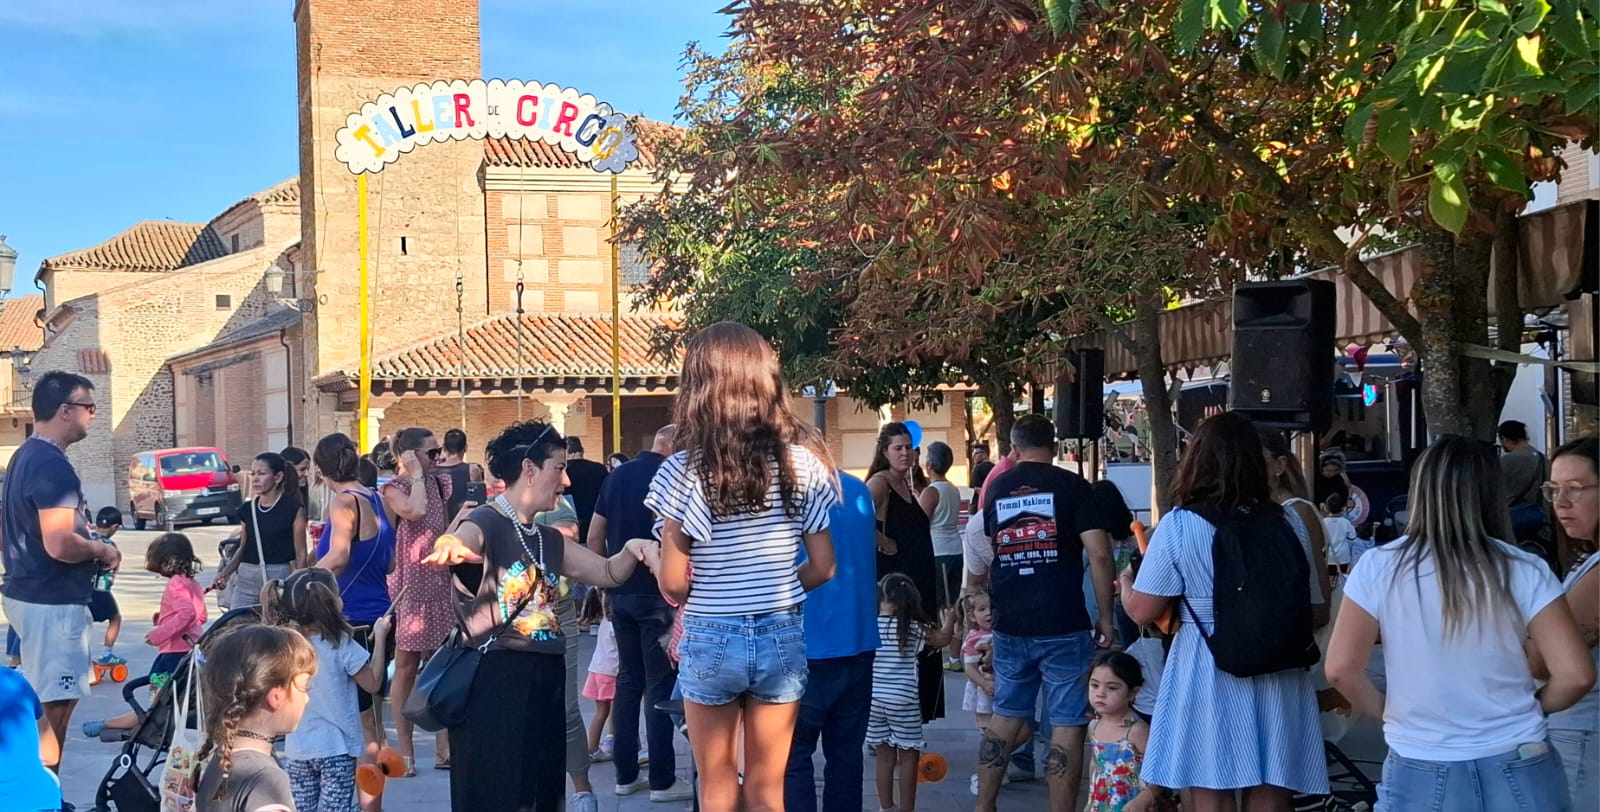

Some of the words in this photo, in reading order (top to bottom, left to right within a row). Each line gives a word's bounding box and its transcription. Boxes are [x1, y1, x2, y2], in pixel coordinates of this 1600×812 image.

[353, 93, 475, 158] TALLER
[488, 105, 500, 116] DE
[517, 95, 623, 159] CIRCO
